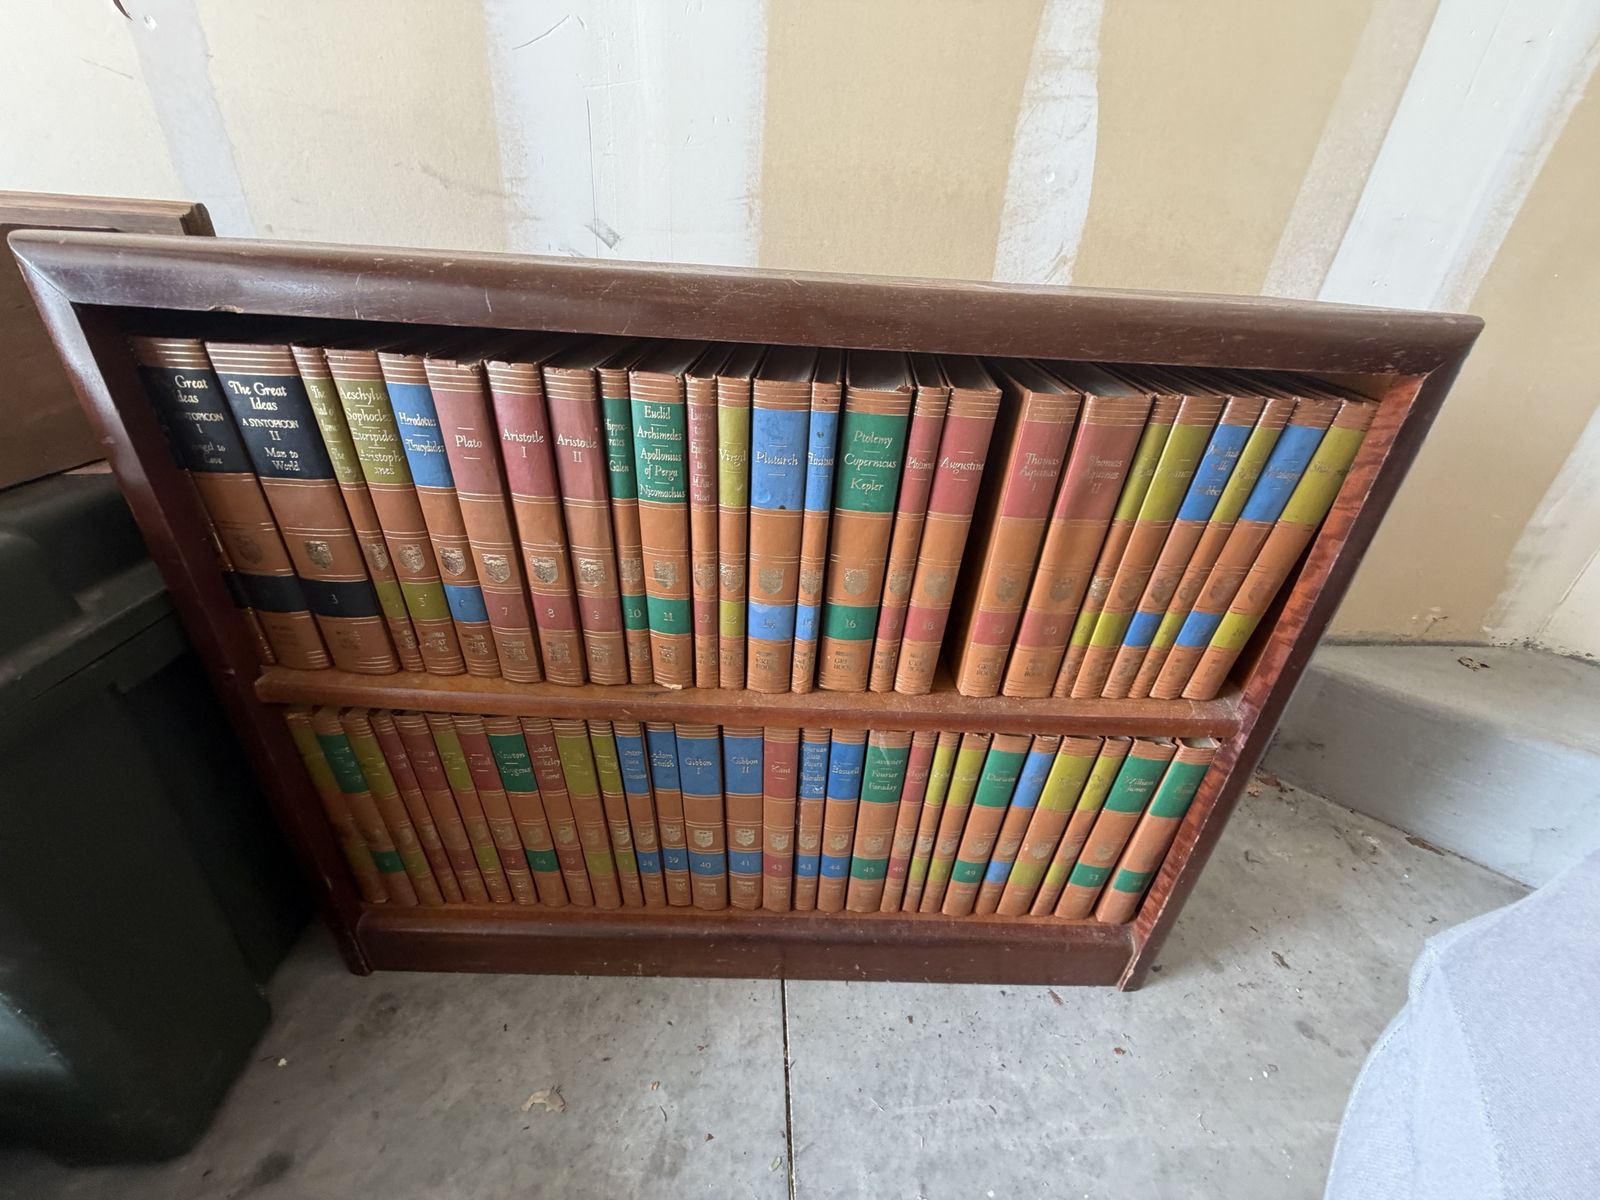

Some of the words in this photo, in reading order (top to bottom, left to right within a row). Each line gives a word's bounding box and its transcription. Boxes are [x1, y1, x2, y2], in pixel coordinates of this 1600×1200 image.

[175, 375, 208, 388] Great
[228, 381, 252, 395] The
[253, 382, 287, 396] Great
[249, 397, 278, 411] Ideas
[644, 405, 671, 419] Euclid
[242, 418, 249, 426] A
[248, 418, 299, 429] SYNTOPICON
[269, 431, 282, 441] II
[503, 429, 544, 444] Aristotle
[637, 425, 682, 441] Archimedes
[853, 430, 893, 448] Ptolemy
[455, 434, 483, 448] Plato
[557, 434, 597, 449] Aristotle
[264, 447, 287, 458] Man
[289, 450, 299, 458] to
[522, 447, 527, 458] I
[573, 451, 583, 463] II
[640, 448, 682, 464] Apollonius
[756, 452, 799, 466] Plutarch
[1025, 452, 1060, 465] Thomas
[272, 460, 301, 471] World
[609, 460, 629, 473] Galen
[844, 452, 897, 471] Copernicus
[940, 456, 985, 474] Augustine
[645, 463, 653, 479] of
[655, 465, 678, 481] Perga
[640, 484, 686, 498] Nicomachus
[851, 478, 884, 494] Kepler
[330, 594, 338, 604] 3
[502, 607, 508, 616] 7
[629, 609, 642, 618] 10
[846, 618, 856, 628] 16
[685, 758, 712, 766] Gibbon
[730, 757, 758, 765] Gibbon
[771, 765, 791, 773] Kant
